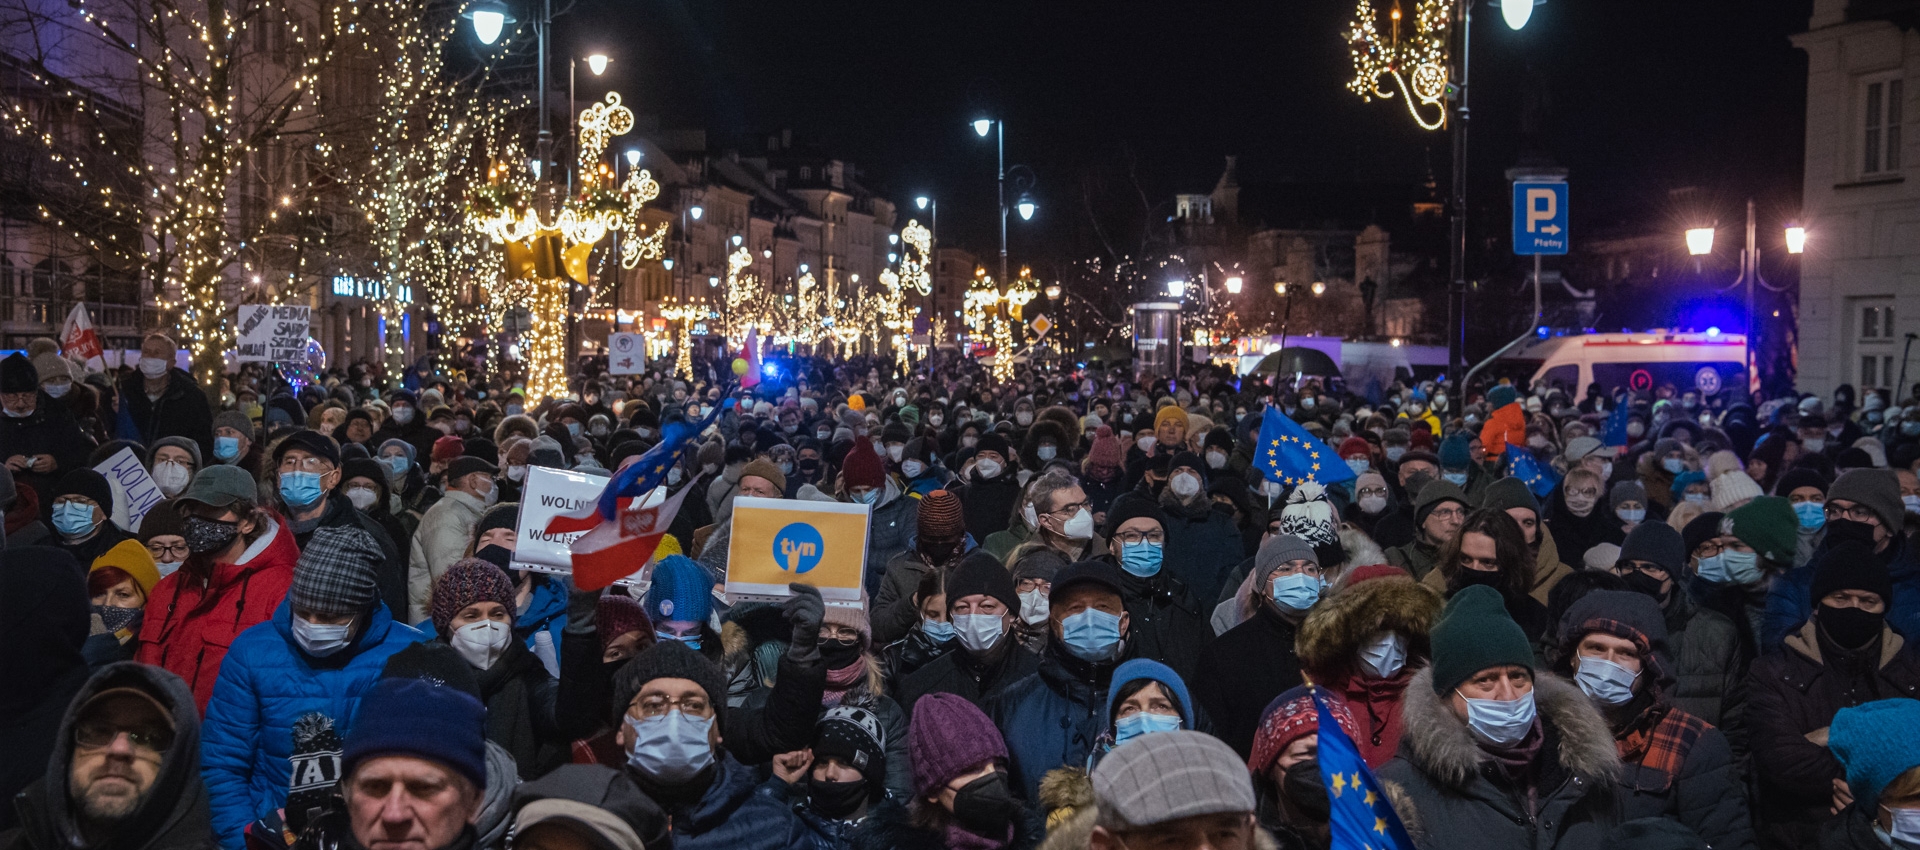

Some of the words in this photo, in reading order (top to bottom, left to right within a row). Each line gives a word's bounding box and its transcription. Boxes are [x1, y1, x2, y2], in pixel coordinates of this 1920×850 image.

[1527, 188, 1557, 233] P
[272, 306, 310, 321] MEDIA
[780, 537, 816, 561] tvn
